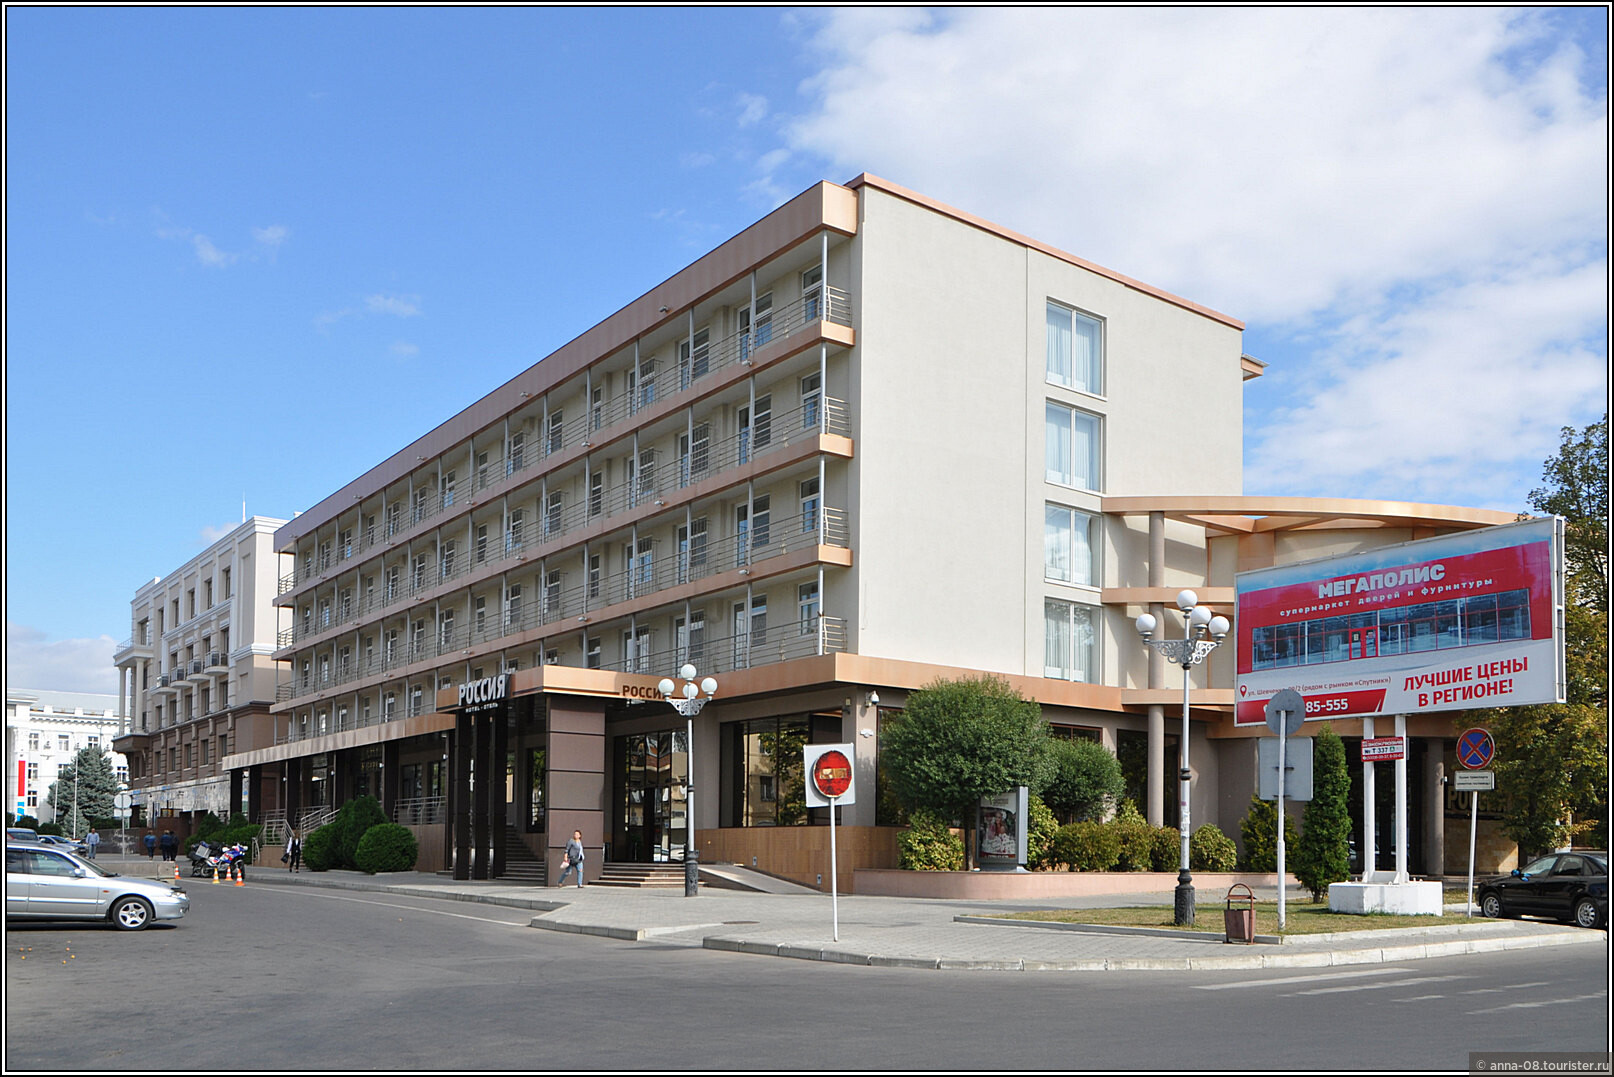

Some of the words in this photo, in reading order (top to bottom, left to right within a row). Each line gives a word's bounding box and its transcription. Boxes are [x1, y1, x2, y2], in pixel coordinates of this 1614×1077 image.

[1279, 600, 1350, 617] супермаркет
[1358, 591, 1400, 605] дверей
[1420, 578, 1493, 596] фурнитуры
[1318, 564, 1446, 599] МЕГАПОЛИС
[1302, 683, 1323, 692] (рядом
[1328, 681, 1354, 691] рынком
[1403, 666, 1473, 691] ЛУЧШИЕ
[1477, 656, 1528, 680] ЦЕНЫ
[458, 674, 506, 706] РОССИЯ
[622, 685, 665, 699] РОССИ
[1418, 693, 1429, 707] В
[1433, 678, 1513, 705] РЕГИОНЕ!
